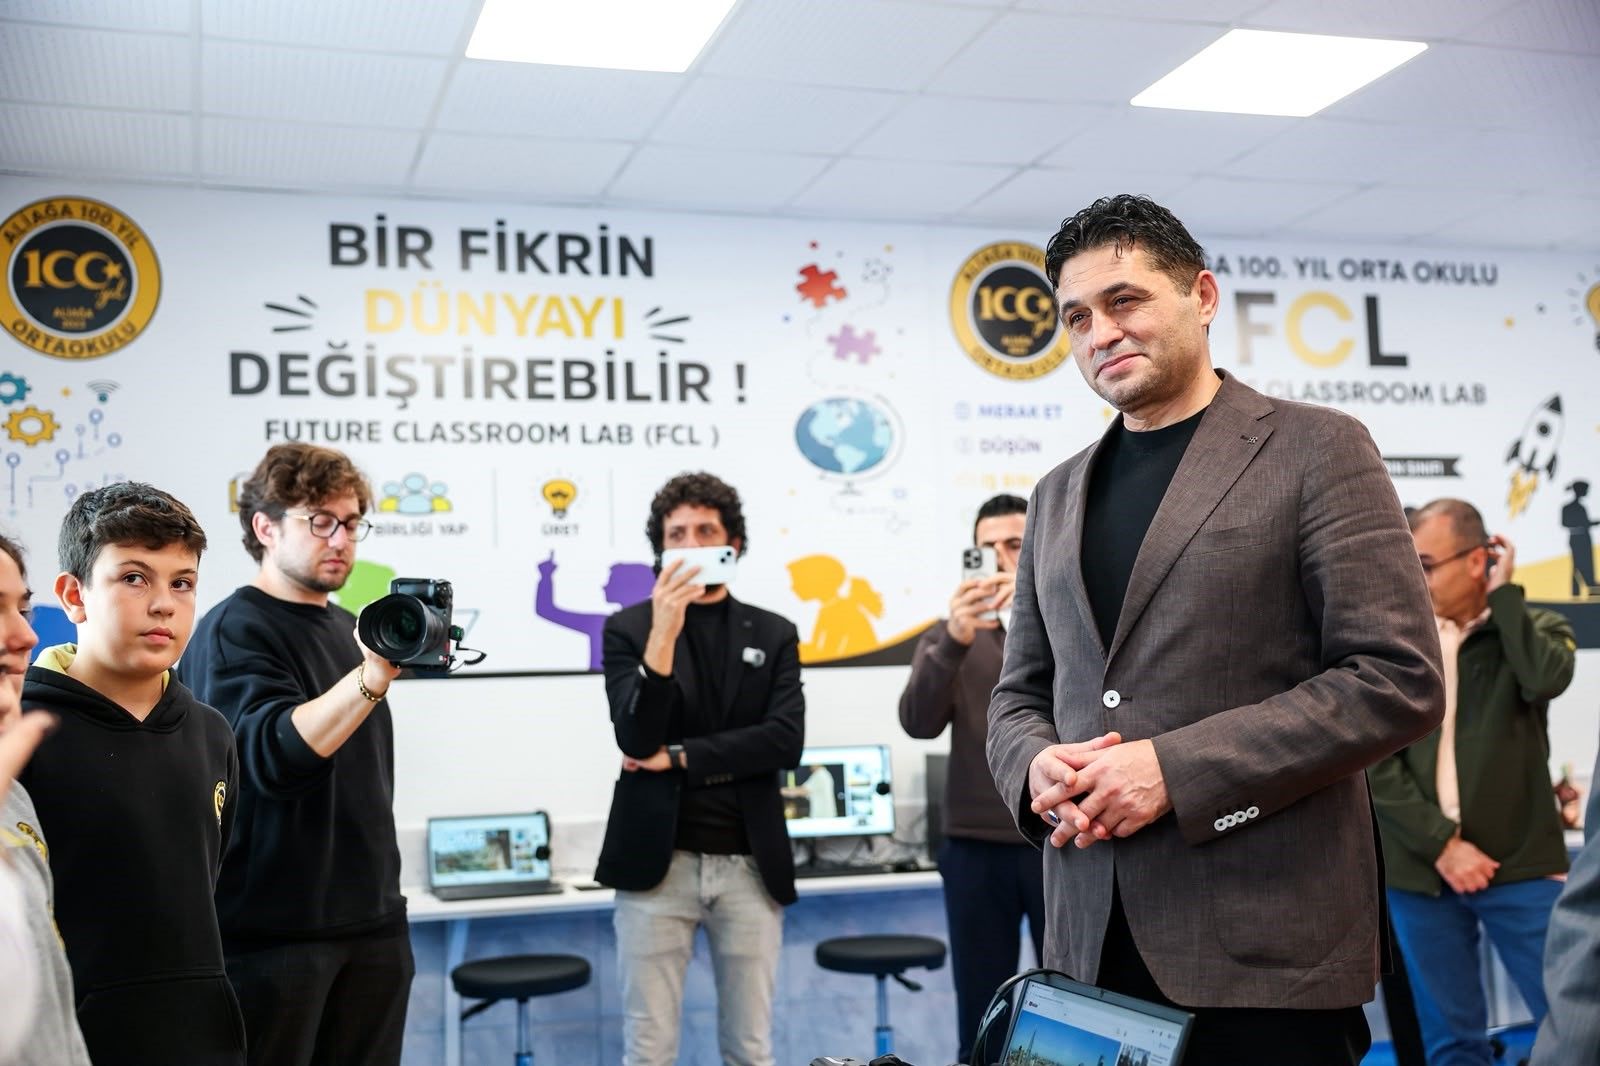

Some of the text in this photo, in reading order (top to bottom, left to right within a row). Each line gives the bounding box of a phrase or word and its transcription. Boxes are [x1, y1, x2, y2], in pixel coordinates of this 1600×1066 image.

[329, 213, 654, 277] BİR FİKRİN
[1239, 257, 1287, 278] 100.
[1298, 258, 1332, 280] YIL
[1339, 259, 1407, 283] ORTA
[1412, 262, 1499, 285] OKULU
[364, 281, 625, 339] DÜNYAYI
[11, 319, 137, 354] ORTAOKULU
[1234, 291, 1408, 367] FCL
[228, 340, 748, 409] DEĞİŞTİREBİLİR !
[1440, 384, 1488, 405] LAB
[977, 403, 1064, 419] MERAK ET
[265, 419, 381, 443] FUTURE
[393, 421, 570, 445] CLASSROOM
[581, 424, 634, 445] LAB
[438, 523, 469, 536] YAP
